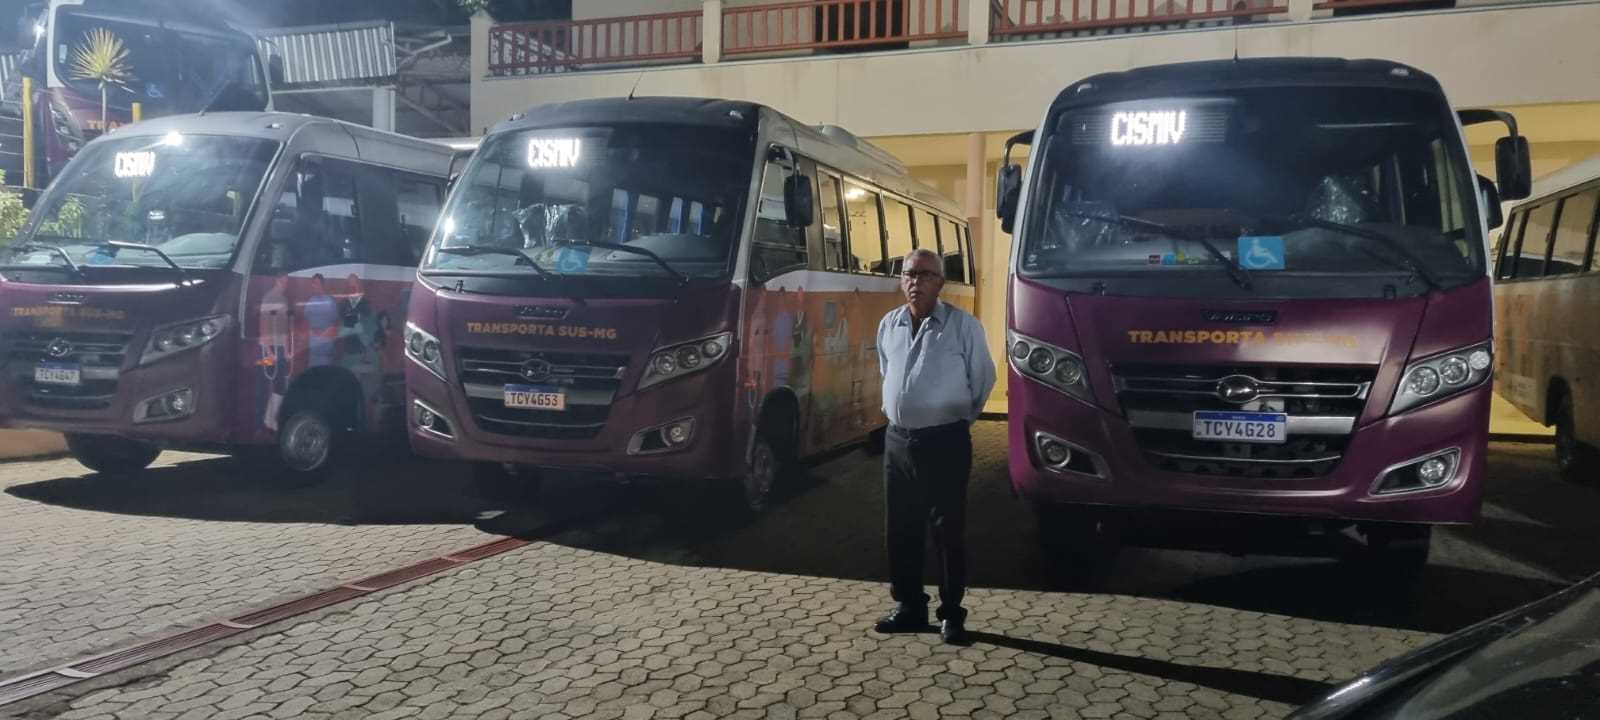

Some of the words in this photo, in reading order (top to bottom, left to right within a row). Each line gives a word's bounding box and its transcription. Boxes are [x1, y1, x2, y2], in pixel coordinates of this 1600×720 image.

[1111, 111, 1186, 145] CISMIV
[466, 322, 555, 335] TRANSPORTA
[558, 325, 617, 339] SUS-MG
[1128, 330, 1266, 344] TRANSPORTA
[510, 392, 558, 407] TCY4G53
[1203, 420, 1276, 438] TCY4G28
